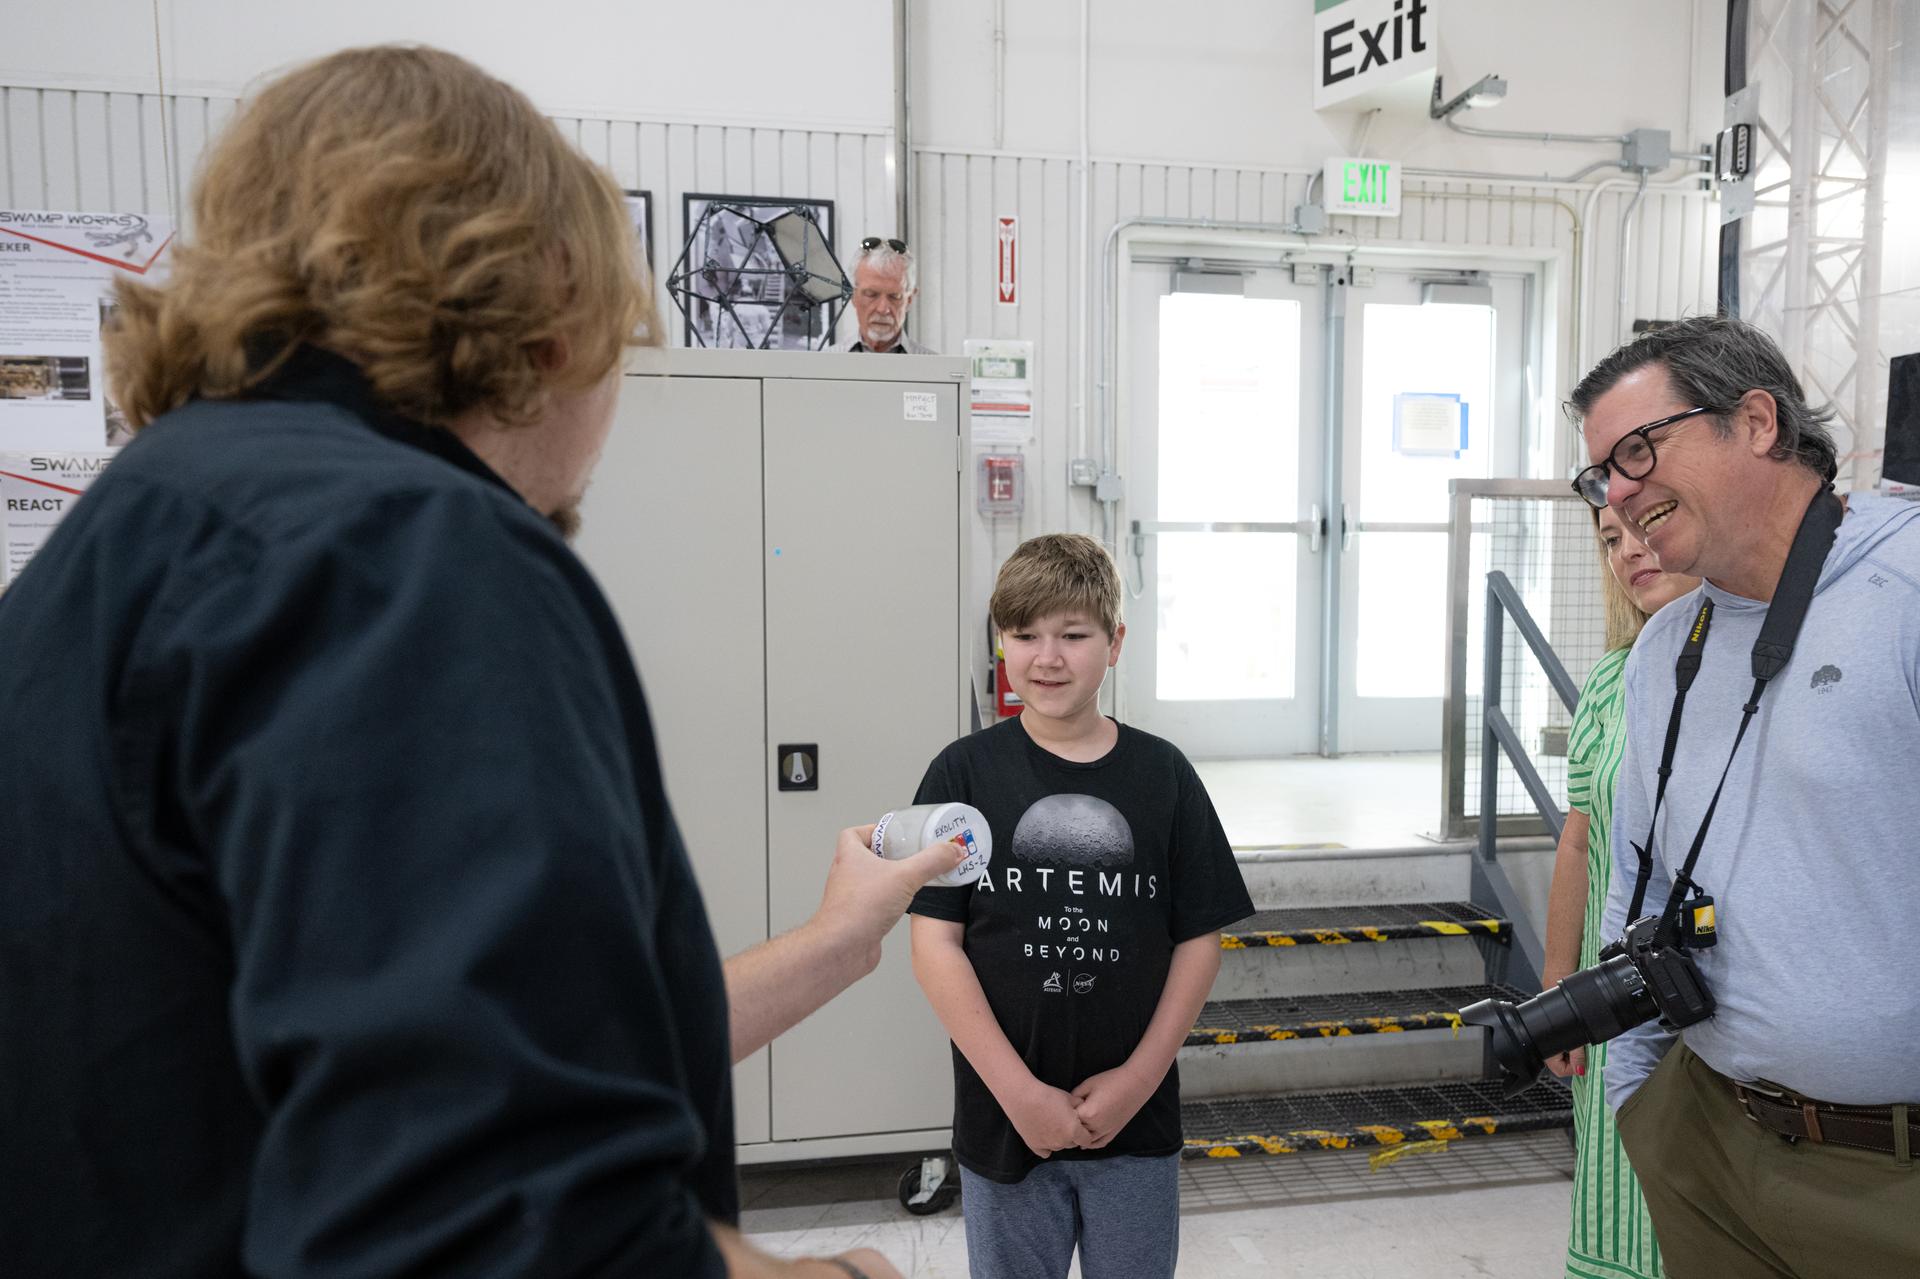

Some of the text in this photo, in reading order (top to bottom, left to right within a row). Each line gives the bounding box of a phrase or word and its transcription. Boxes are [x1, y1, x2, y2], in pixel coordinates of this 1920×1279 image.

[1322, 0, 1427, 88] Exit
[1343, 162, 1392, 205] EXIT
[0, 211, 133, 226] SWAMP WORKS
[7, 499, 63, 511] REACT
[1691, 607, 1708, 642] Nikon
[934, 815, 967, 839] EXOLITH
[958, 854, 987, 876] LHS-2
[977, 867, 1157, 899] ARTEMIS
[1038, 916, 1108, 933] MOON
[1066, 935, 1079, 943] and
[1024, 943, 1120, 962] BEYOND
